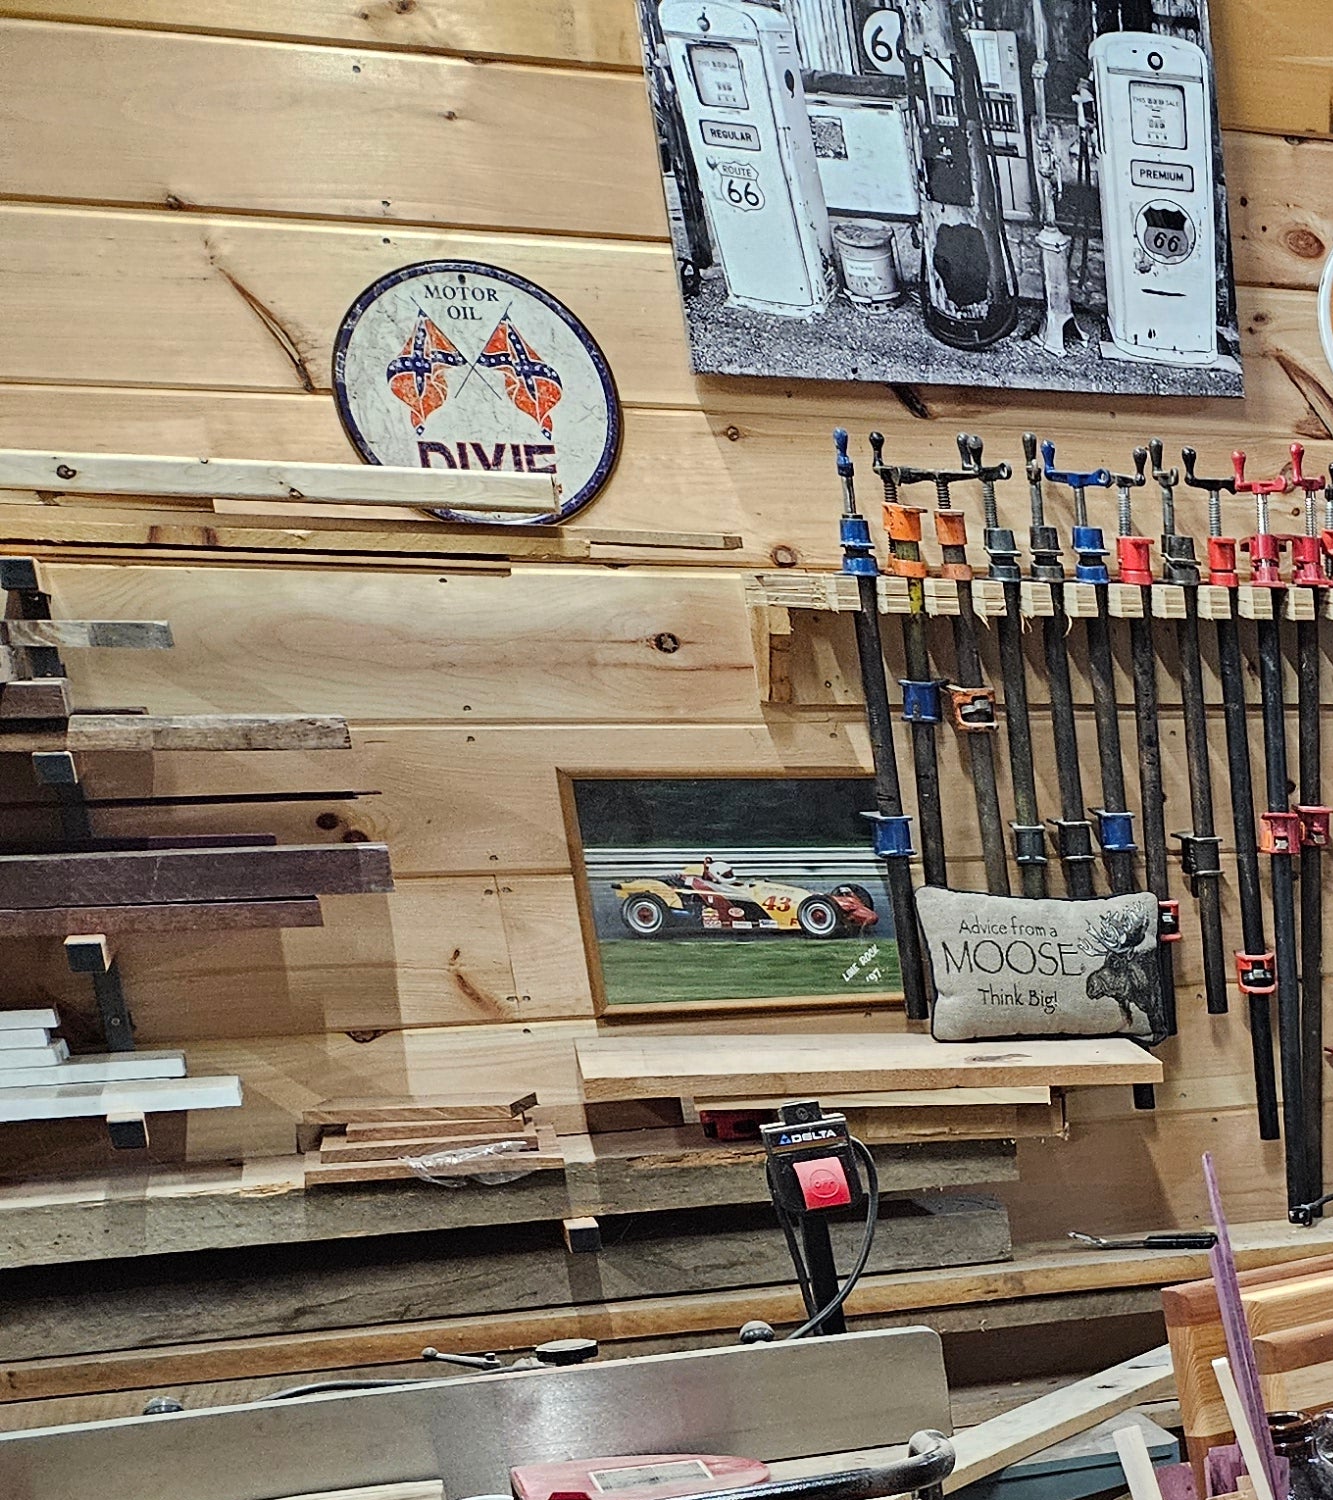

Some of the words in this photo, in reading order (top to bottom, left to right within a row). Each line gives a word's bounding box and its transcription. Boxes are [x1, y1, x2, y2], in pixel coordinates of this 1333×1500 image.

[709, 128, 752, 142] REGULAR
[722, 165, 752, 177] ROUTE
[1139, 168, 1184, 182] PREMIUM
[728, 179, 759, 206] 66
[1154, 232, 1181, 252] 66
[424, 285, 499, 301] MOTOR
[447, 305, 483, 321] OIL
[762, 895, 792, 912] 43
[959, 913, 1008, 935] Advice
[1011, 916, 1046, 936] from
[1049, 927, 1058, 937] a
[859, 943, 880, 966] ROCK
[942, 939, 1084, 976] MOOSE
[977, 984, 1024, 1006] Think
[1028, 990, 1058, 1014] Big!
[790, 1129, 837, 1143] DELTA
